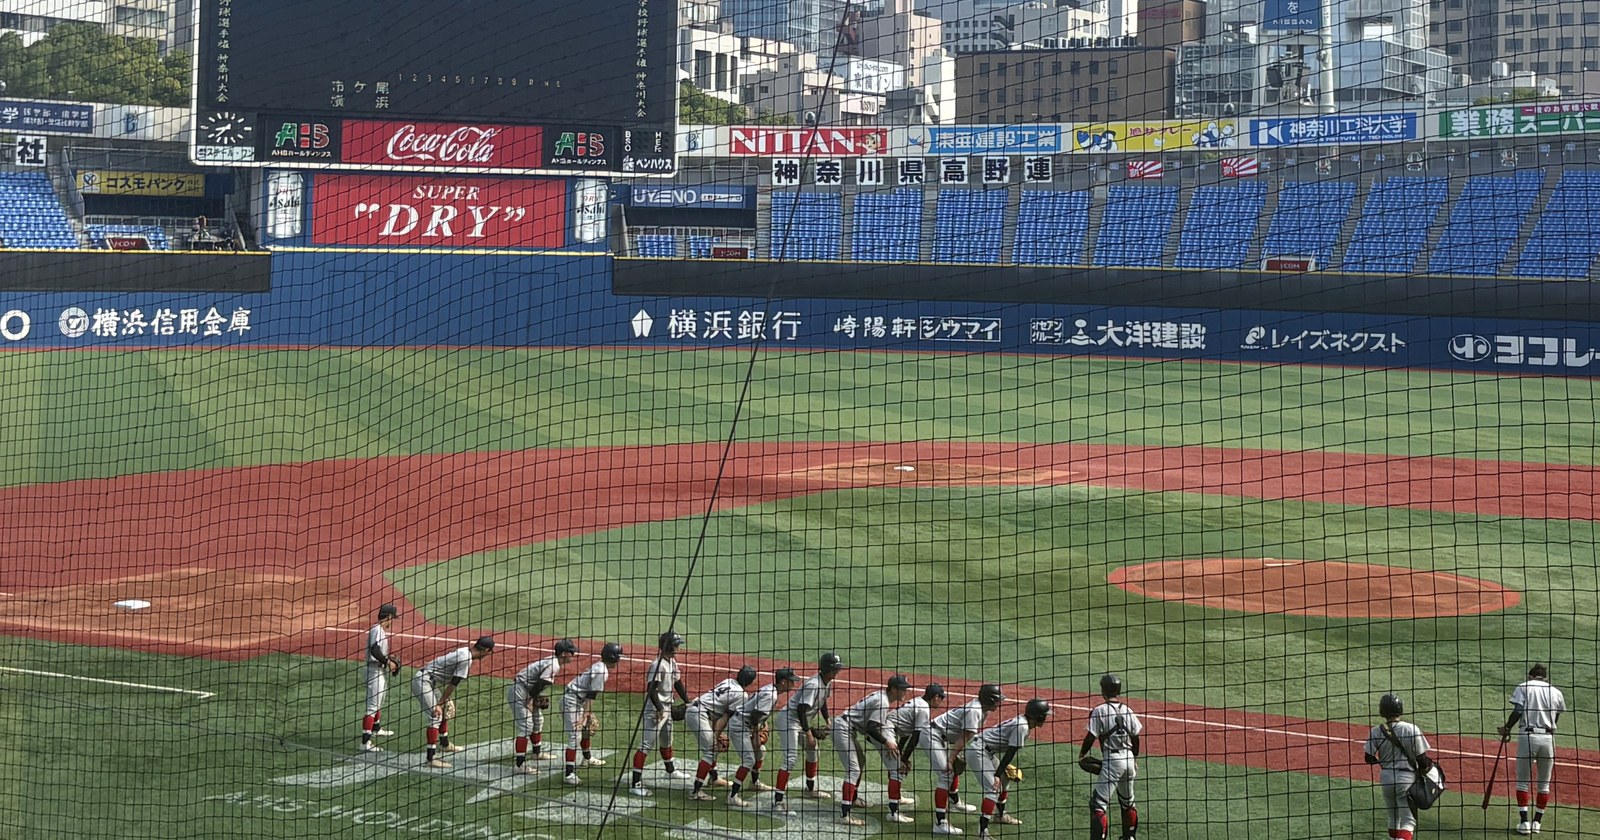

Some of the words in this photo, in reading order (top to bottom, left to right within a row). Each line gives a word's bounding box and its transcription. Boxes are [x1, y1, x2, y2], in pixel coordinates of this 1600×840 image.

[1288, 115, 1407, 138] 神奈川工科大学
[17, 137, 45, 164] 社
[387, 124, 502, 163] Coca-Cola
[731, 130, 855, 153] NITTAN
[935, 131, 1056, 150] 東亜建設工業
[413, 185, 480, 200] SUPER
[633, 188, 697, 204] UYENO
[91, 306, 252, 337] 横浜信用金庫
[667, 308, 802, 341] 横浜銀行
[833, 315, 917, 339] 崎陽軒
[922, 318, 999, 341] シウマイ
[1096, 319, 1207, 350] 大洋建設
[1271, 328, 1406, 354] レイズネクスト
[1494, 334, 1600, 367] ヨコレ
